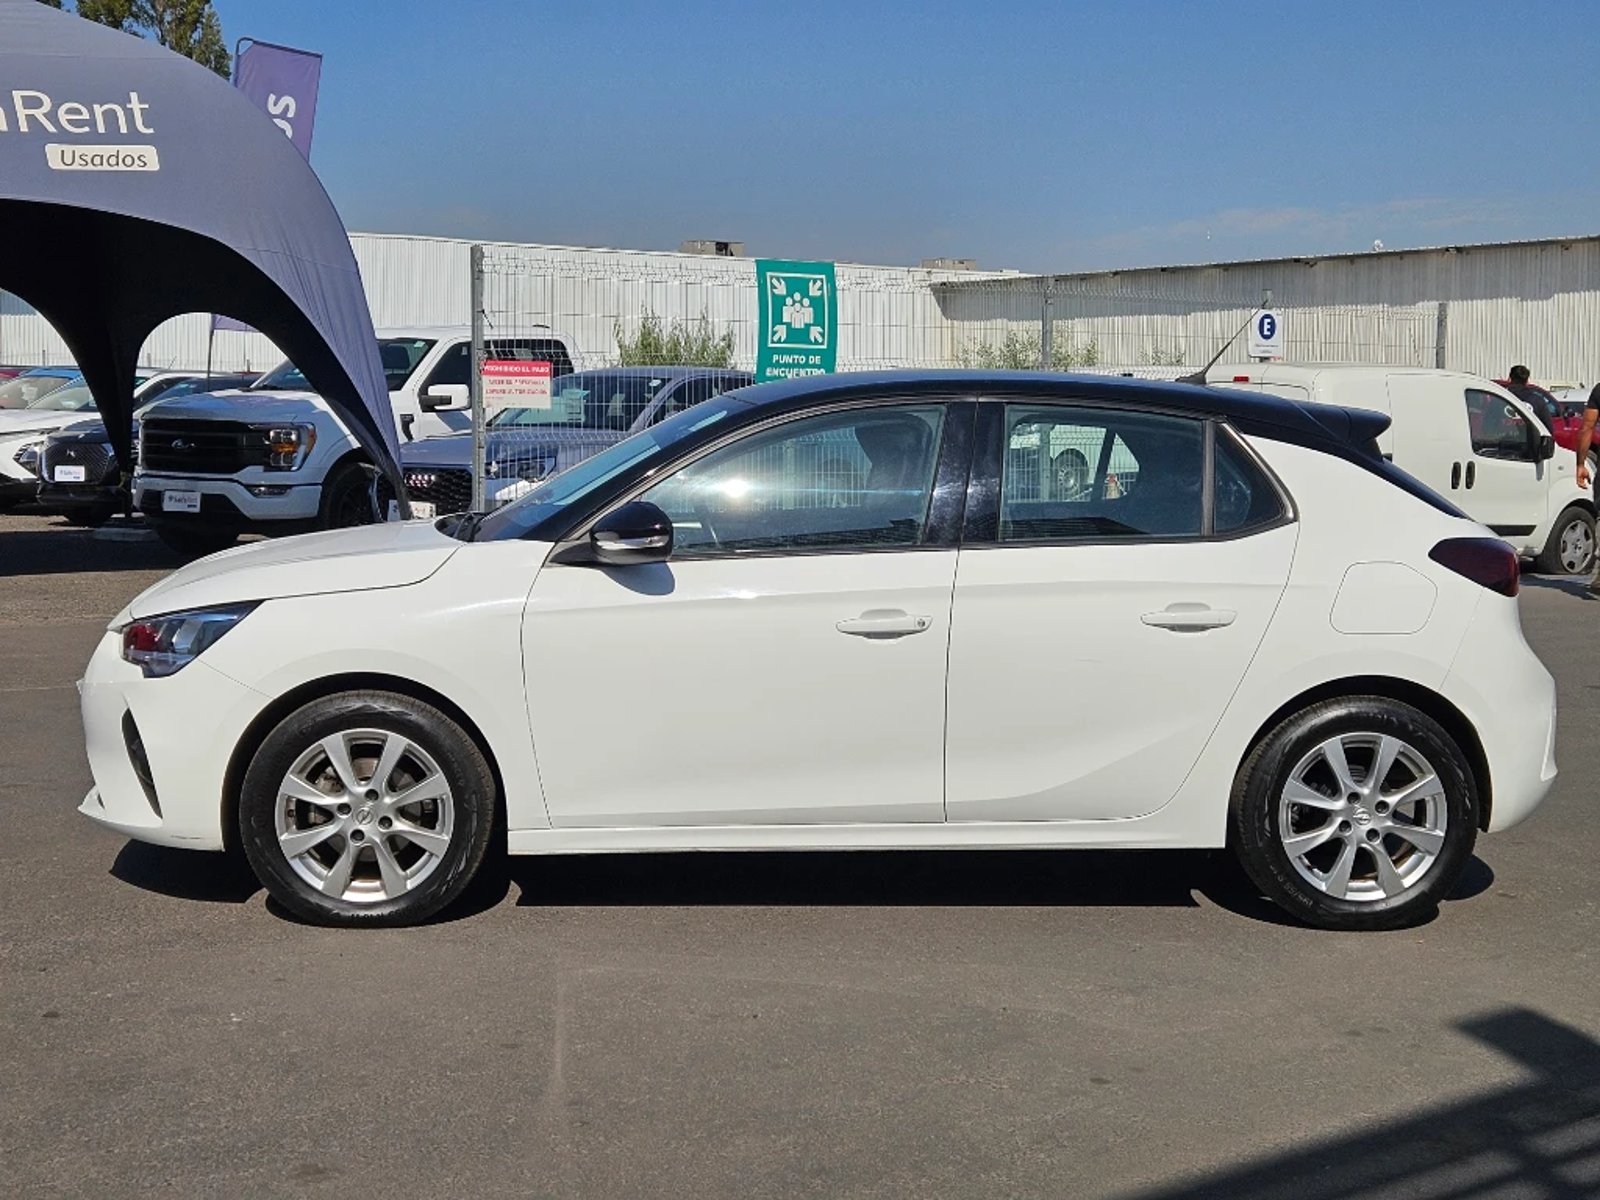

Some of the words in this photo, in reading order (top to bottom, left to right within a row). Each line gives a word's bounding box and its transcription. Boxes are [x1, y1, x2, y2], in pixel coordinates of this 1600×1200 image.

[60, 149, 148, 168] Usados
[1263, 318, 1272, 335] E
[772, 354, 806, 364] PUNTO
[808, 355, 821, 364] DE
[765, 366, 826, 379] ENCUENTRO
